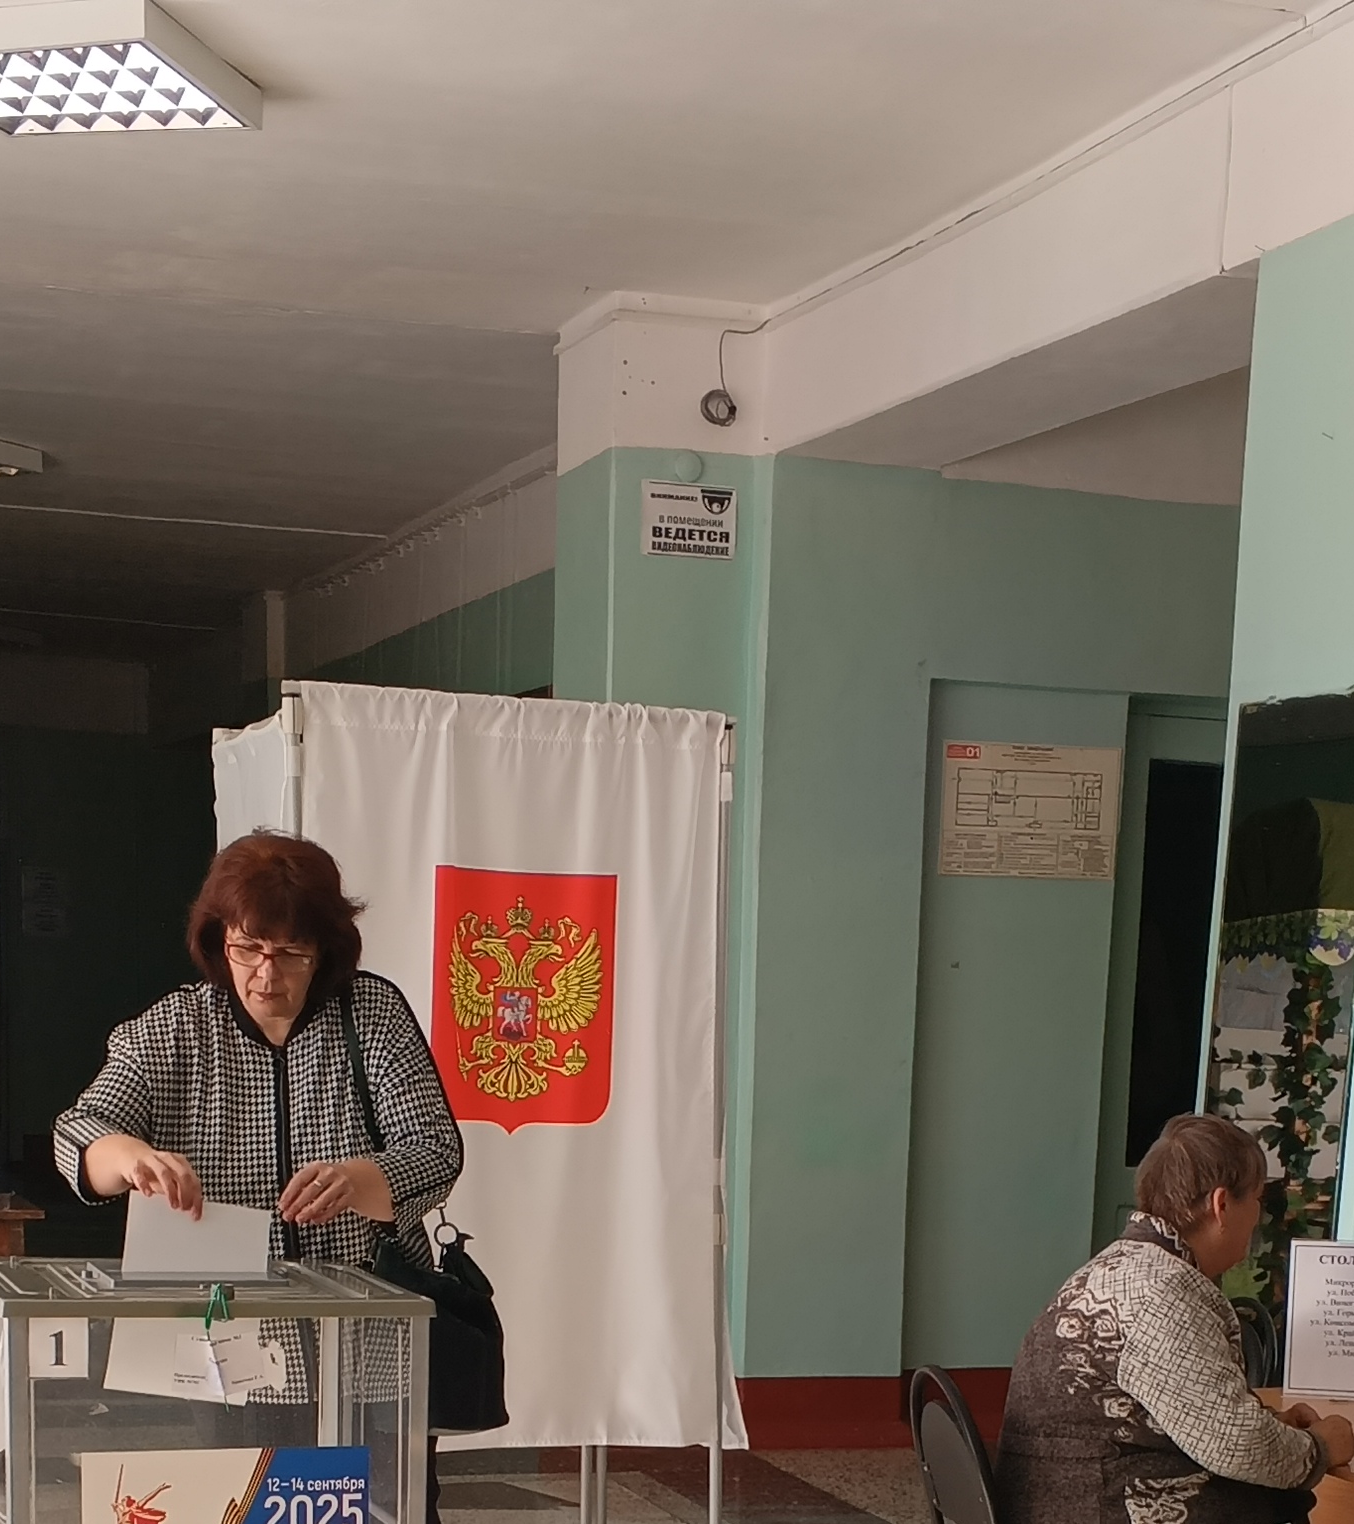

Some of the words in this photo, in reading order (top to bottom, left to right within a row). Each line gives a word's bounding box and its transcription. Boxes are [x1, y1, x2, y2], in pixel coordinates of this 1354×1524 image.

[652, 526, 730, 543] ВЕДЕТСЯ
[651, 541, 729, 556] ВИДЕОНАБЛЮДЕНИЕ
[966, 747, 980, 757] 01
[49, 1330, 67, 1366] 1
[307, 1476, 365, 1491] сентября
